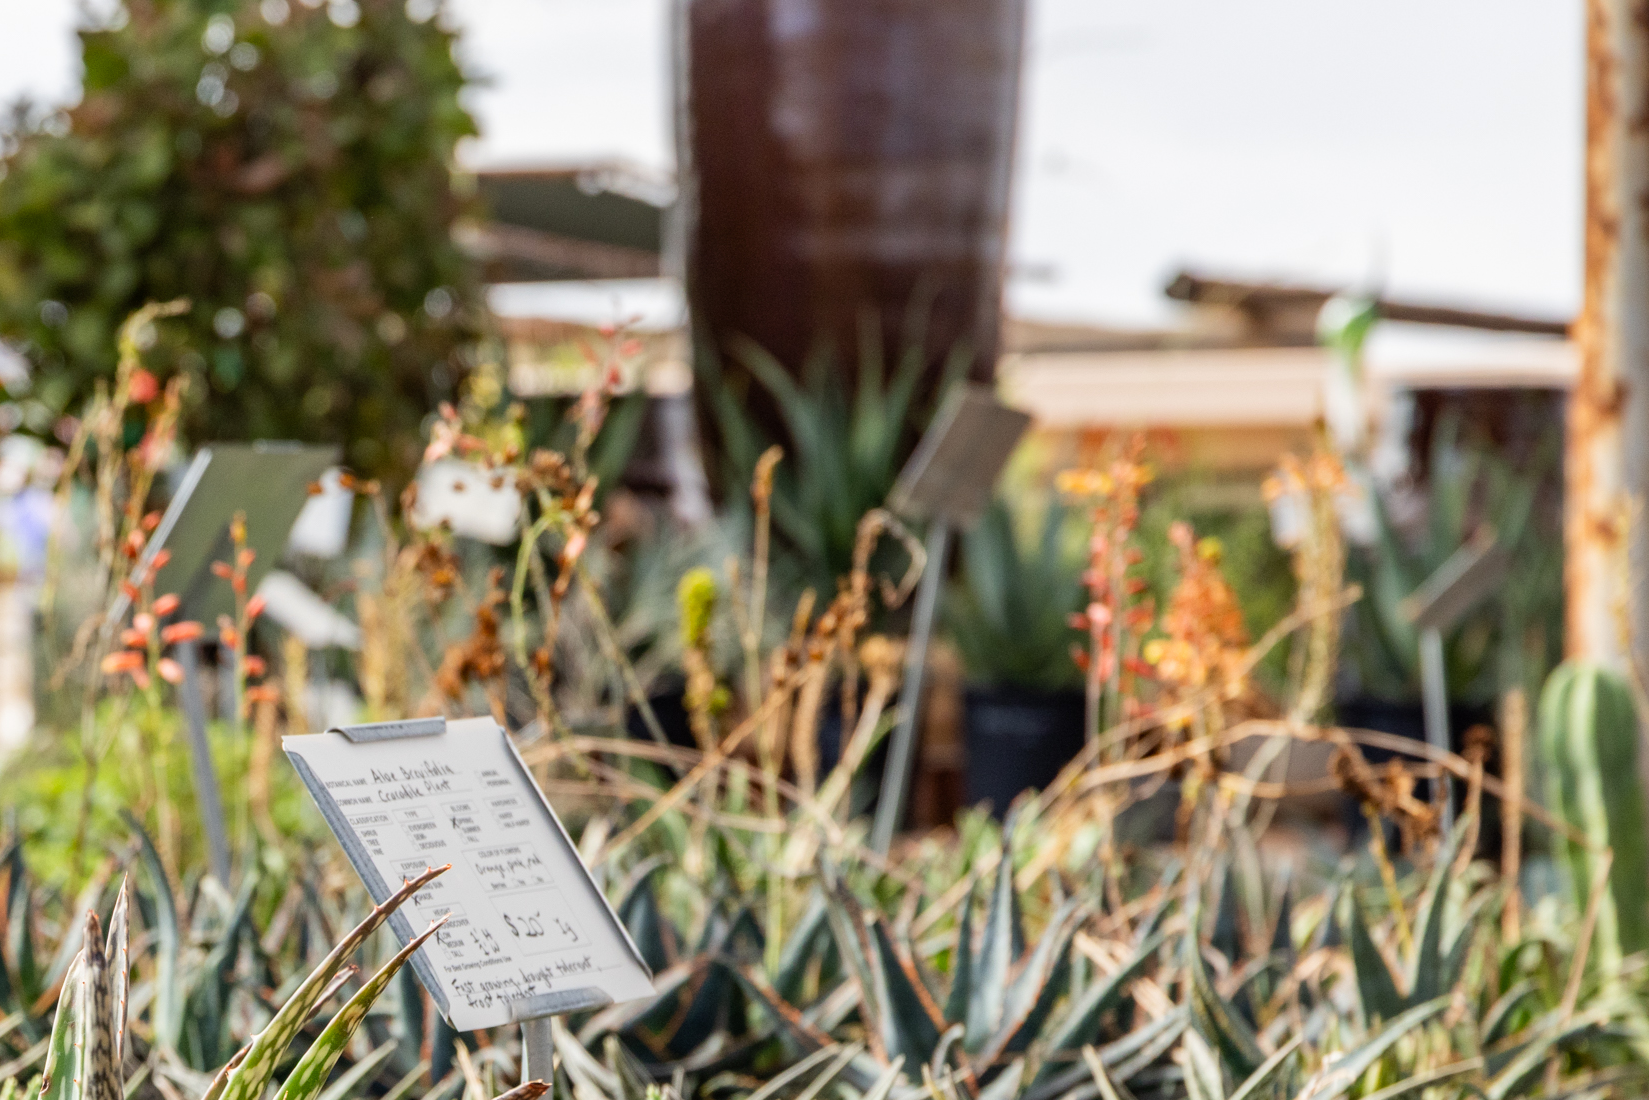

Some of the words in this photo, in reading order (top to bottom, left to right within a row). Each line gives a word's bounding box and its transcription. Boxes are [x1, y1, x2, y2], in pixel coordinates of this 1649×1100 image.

[352, 778, 367, 786] NAME
[370, 769, 398, 783] Aloe
[399, 761, 455, 780] Brevifolia
[358, 796, 373, 804] NAME
[378, 785, 424, 803] Crocodile
[423, 779, 451, 792] Plant
[404, 810, 418, 818] TYPE
[400, 860, 428, 870] EXPOSURE
[481, 930, 493, 940] H
[450, 950, 464, 958] TALL
[443, 965, 452, 973] For
[451, 964, 462, 972] Best
[461, 962, 482, 970] Growing
[451, 978, 474, 996] Fast
[466, 990, 492, 1008] frost
